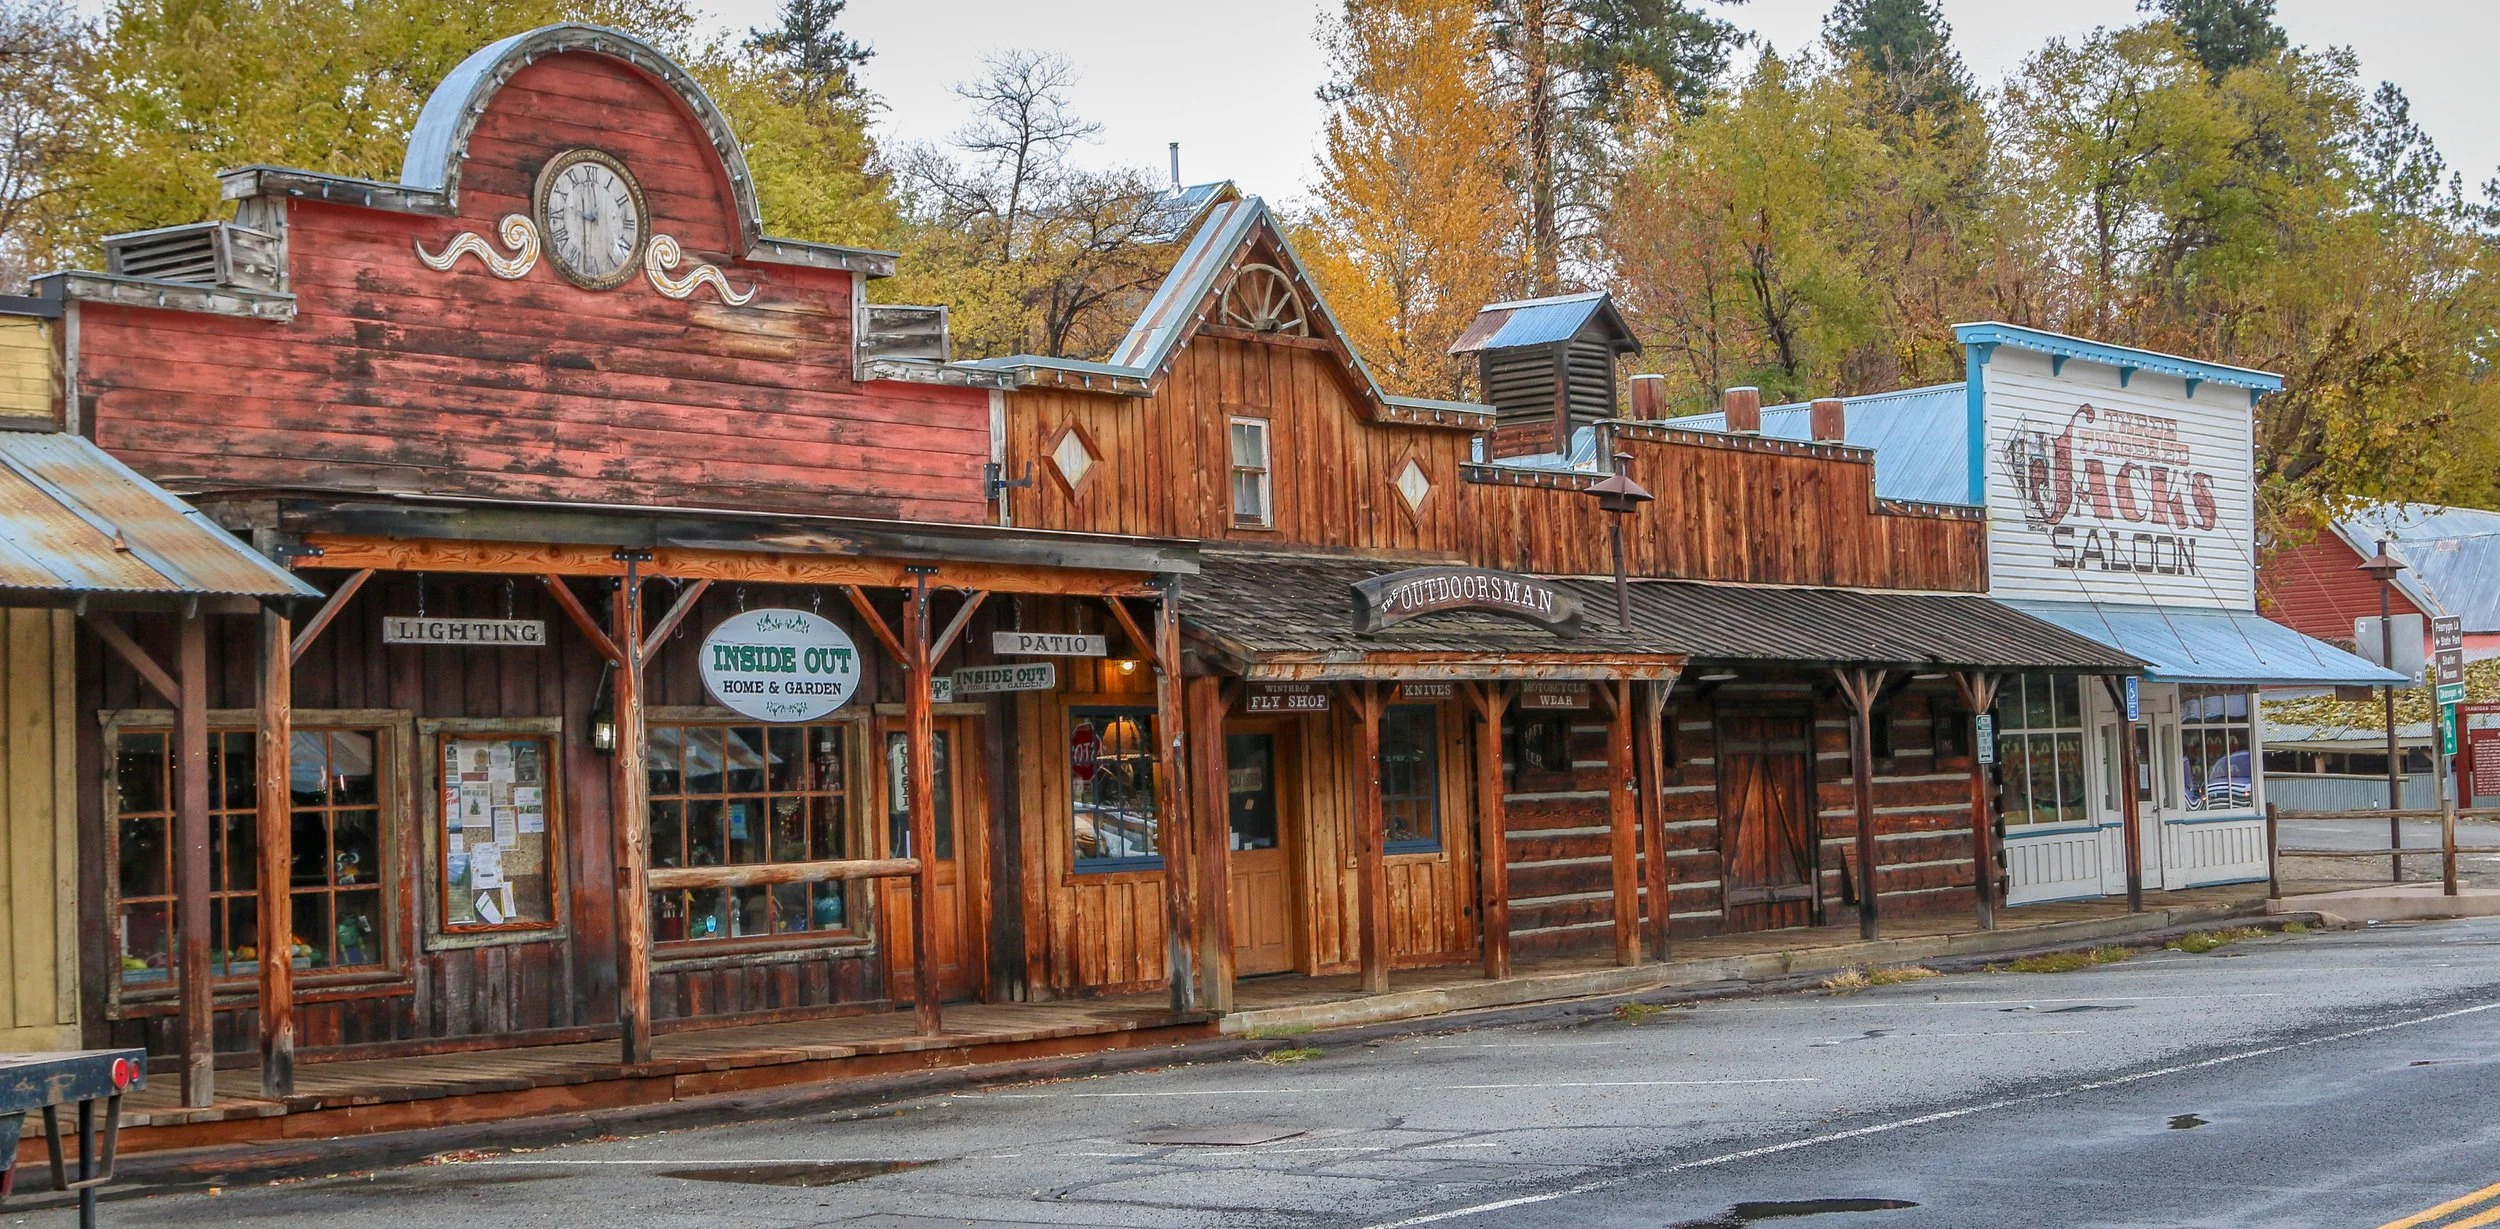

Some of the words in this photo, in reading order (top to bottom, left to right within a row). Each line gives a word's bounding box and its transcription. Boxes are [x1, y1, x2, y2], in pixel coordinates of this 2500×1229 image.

[2103, 408, 2178, 441] THREE
[2079, 430, 2190, 466] FINGERED
[2029, 403, 2217, 531] JACK'S
[2053, 526, 2196, 576] SALOON
[1380, 588, 1399, 613] THE
[1401, 575, 1553, 615] OUTDOORSMAN
[399, 622, 537, 642] LIGHTING
[1018, 635, 1088, 652] PATIO
[713, 644, 797, 673] INSIDE
[804, 647, 852, 674] OUT
[955, 670, 1013, 685] INSIDE
[1016, 667, 1047, 682] OUT
[723, 680, 764, 694] HOME
[768, 681, 780, 694] &
[785, 682, 842, 695] GARDEN
[1007, 681, 1042, 689] GARDEN
[1265, 685, 1311, 693] WINTHROP
[1404, 684, 1451, 696] KNIVES
[1523, 682, 1586, 693] MOTORCYCLE
[1251, 696, 1281, 709] FLY
[1288, 695, 1326, 707] SHOP
[1539, 695, 1574, 706] WEAR
